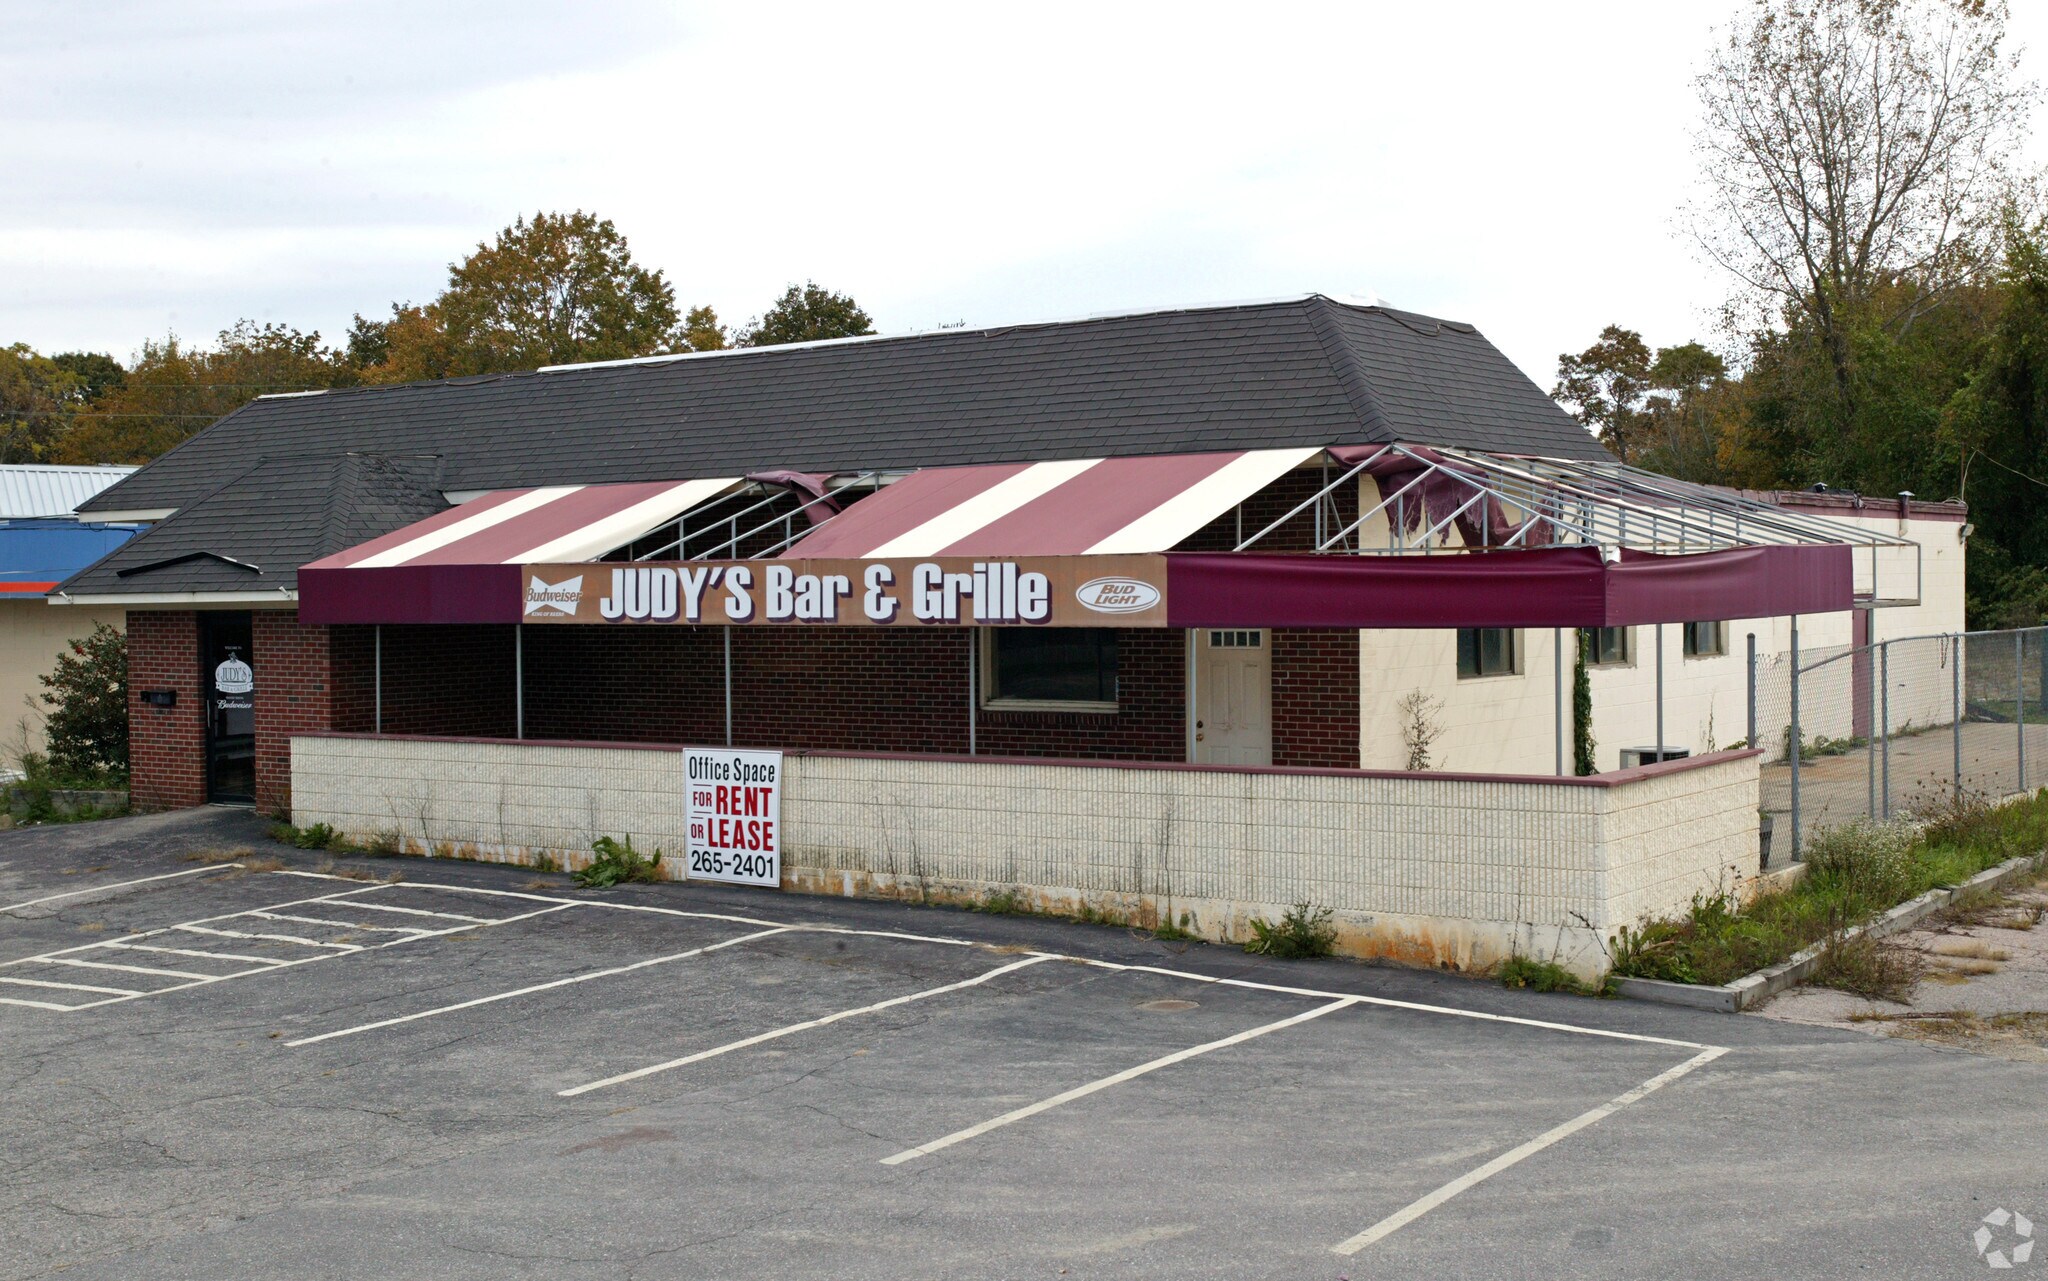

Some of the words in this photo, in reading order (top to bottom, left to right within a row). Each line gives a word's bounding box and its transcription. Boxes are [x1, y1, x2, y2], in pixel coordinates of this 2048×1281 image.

[526, 587, 582, 602] Budweiser
[600, 566, 754, 622] JUDY'S
[766, 565, 851, 622] Bar
[864, 564, 899, 623] &
[913, 562, 1051, 624] Grille
[1094, 595, 1141, 605] LIGHT
[1101, 584, 1136, 595] BUD
[220, 667, 248, 681] JUDY'S
[216, 699, 253, 709] Budweiser
[689, 756, 730, 781] Office
[733, 757, 775, 785] Space
[693, 791, 713, 807] FOR
[716, 785, 773, 817] RENT
[690, 823, 704, 839] OR
[708, 818, 774, 851] LEASE
[691, 850, 774, 878] 265-2401
